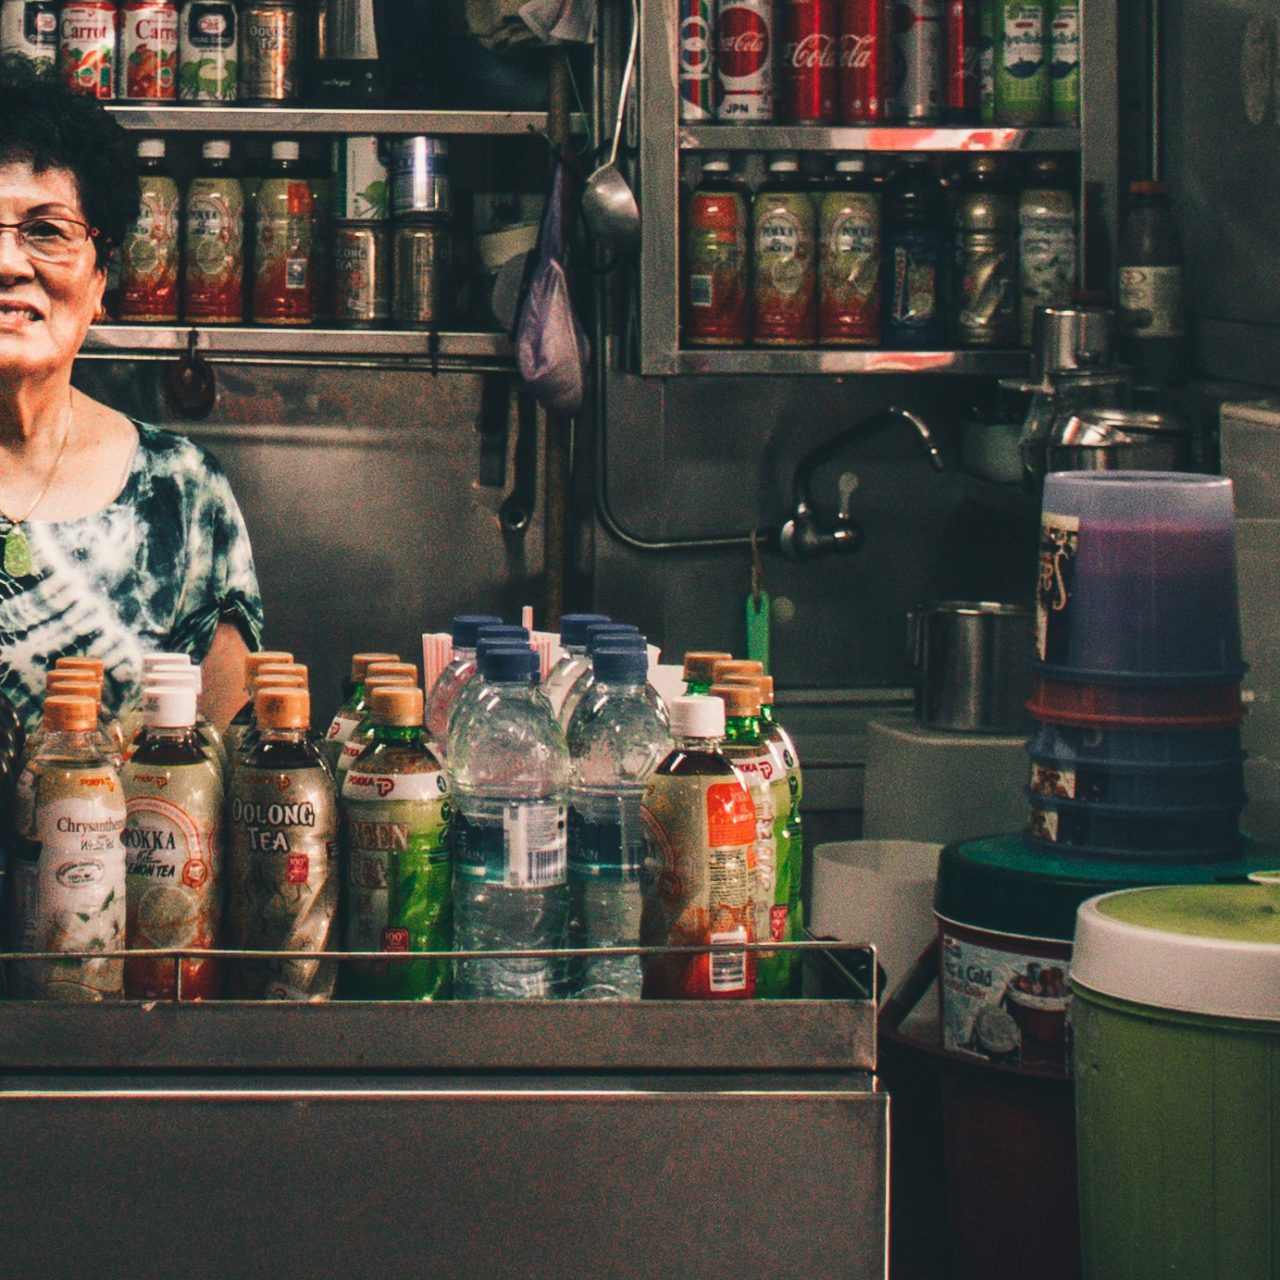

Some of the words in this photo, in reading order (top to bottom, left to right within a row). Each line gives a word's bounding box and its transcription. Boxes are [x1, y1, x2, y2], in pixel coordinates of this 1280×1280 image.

[61, 18, 107, 39] Carrot
[135, 19, 177, 40] Carro
[725, 104, 749, 114] JPN
[231, 797, 316, 826] OOLONG
[57, 816, 122, 837] Chrysanthe
[246, 826, 290, 853] TEA
[125, 862, 154, 877] EMON
[156, 864, 176, 878] TEA
